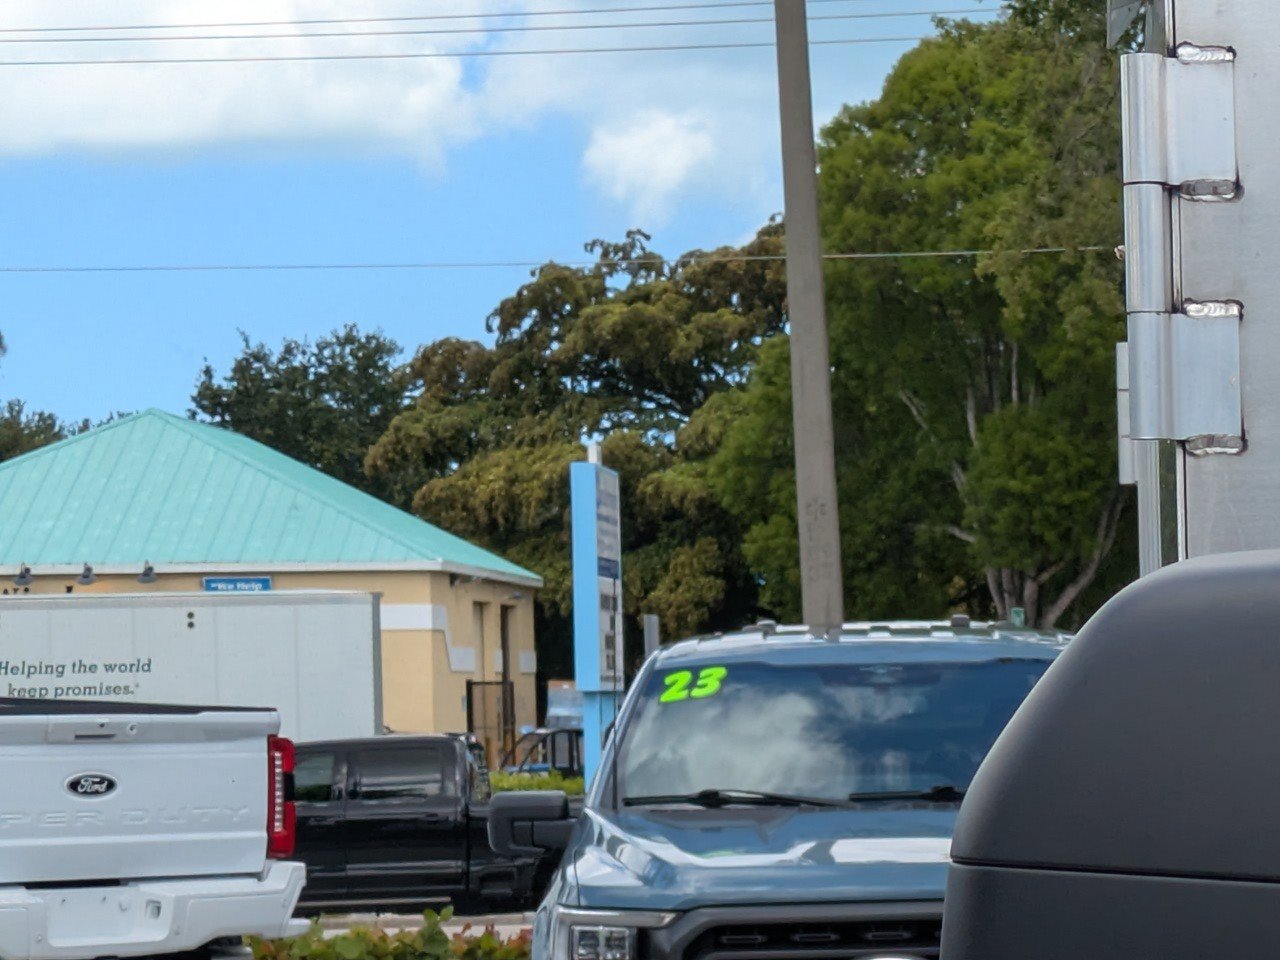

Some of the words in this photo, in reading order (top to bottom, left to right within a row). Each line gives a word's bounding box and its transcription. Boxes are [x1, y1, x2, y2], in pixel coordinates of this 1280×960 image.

[0, 660, 66, 679] Helping
[72, 659, 98, 674] the
[103, 658, 152, 673] world
[7, 683, 49, 698] keep
[54, 682, 135, 698] promises.
[660, 666, 727, 702] 23
[77, 777, 108, 793] Ford
